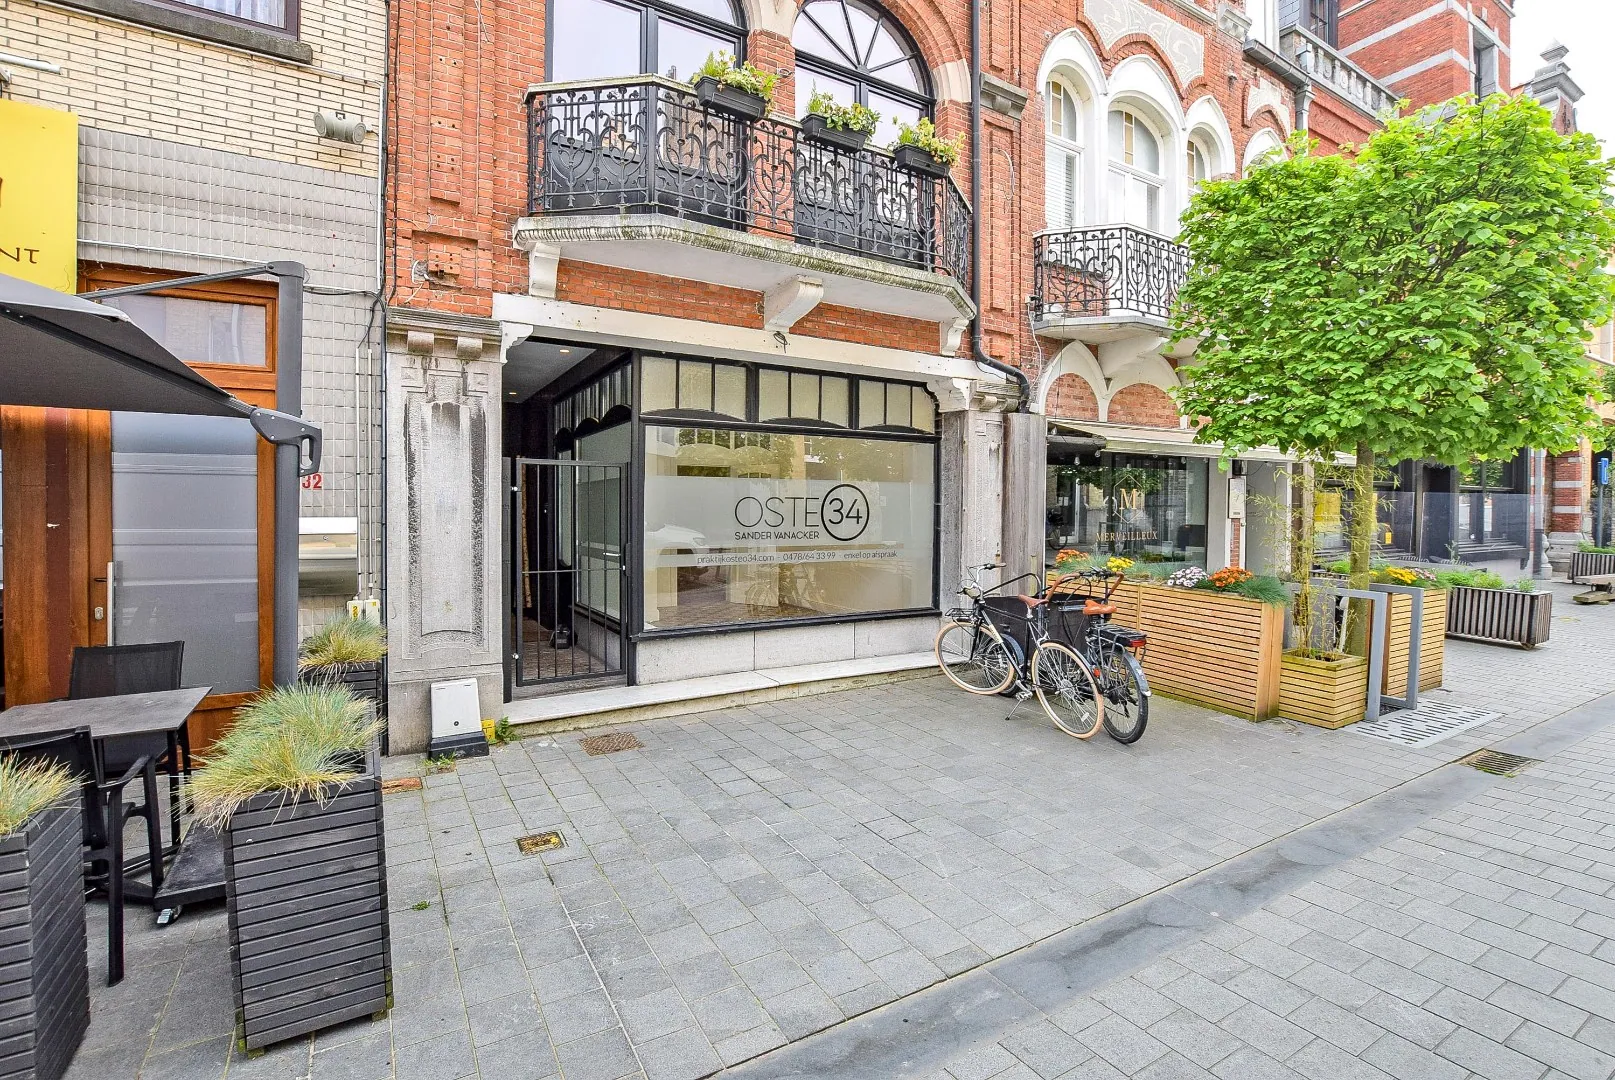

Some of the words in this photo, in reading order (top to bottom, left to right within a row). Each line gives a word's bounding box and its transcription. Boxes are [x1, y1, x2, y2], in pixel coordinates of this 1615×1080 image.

[302, 474, 322, 489] 32
[1119, 488, 1138, 510] M
[828, 497, 863, 525] 34
[734, 531, 772, 540] SANDER
[774, 530, 820, 540] VANACKER
[1096, 531, 1158, 542] MERVEILLEUX
[697, 553, 775, 565] praktijkosteo34.com
[782, 552, 815, 561] 0478/64
[816, 552, 826, 560] 33
[827, 551, 836, 560] 99
[843, 551, 862, 559] enkel
